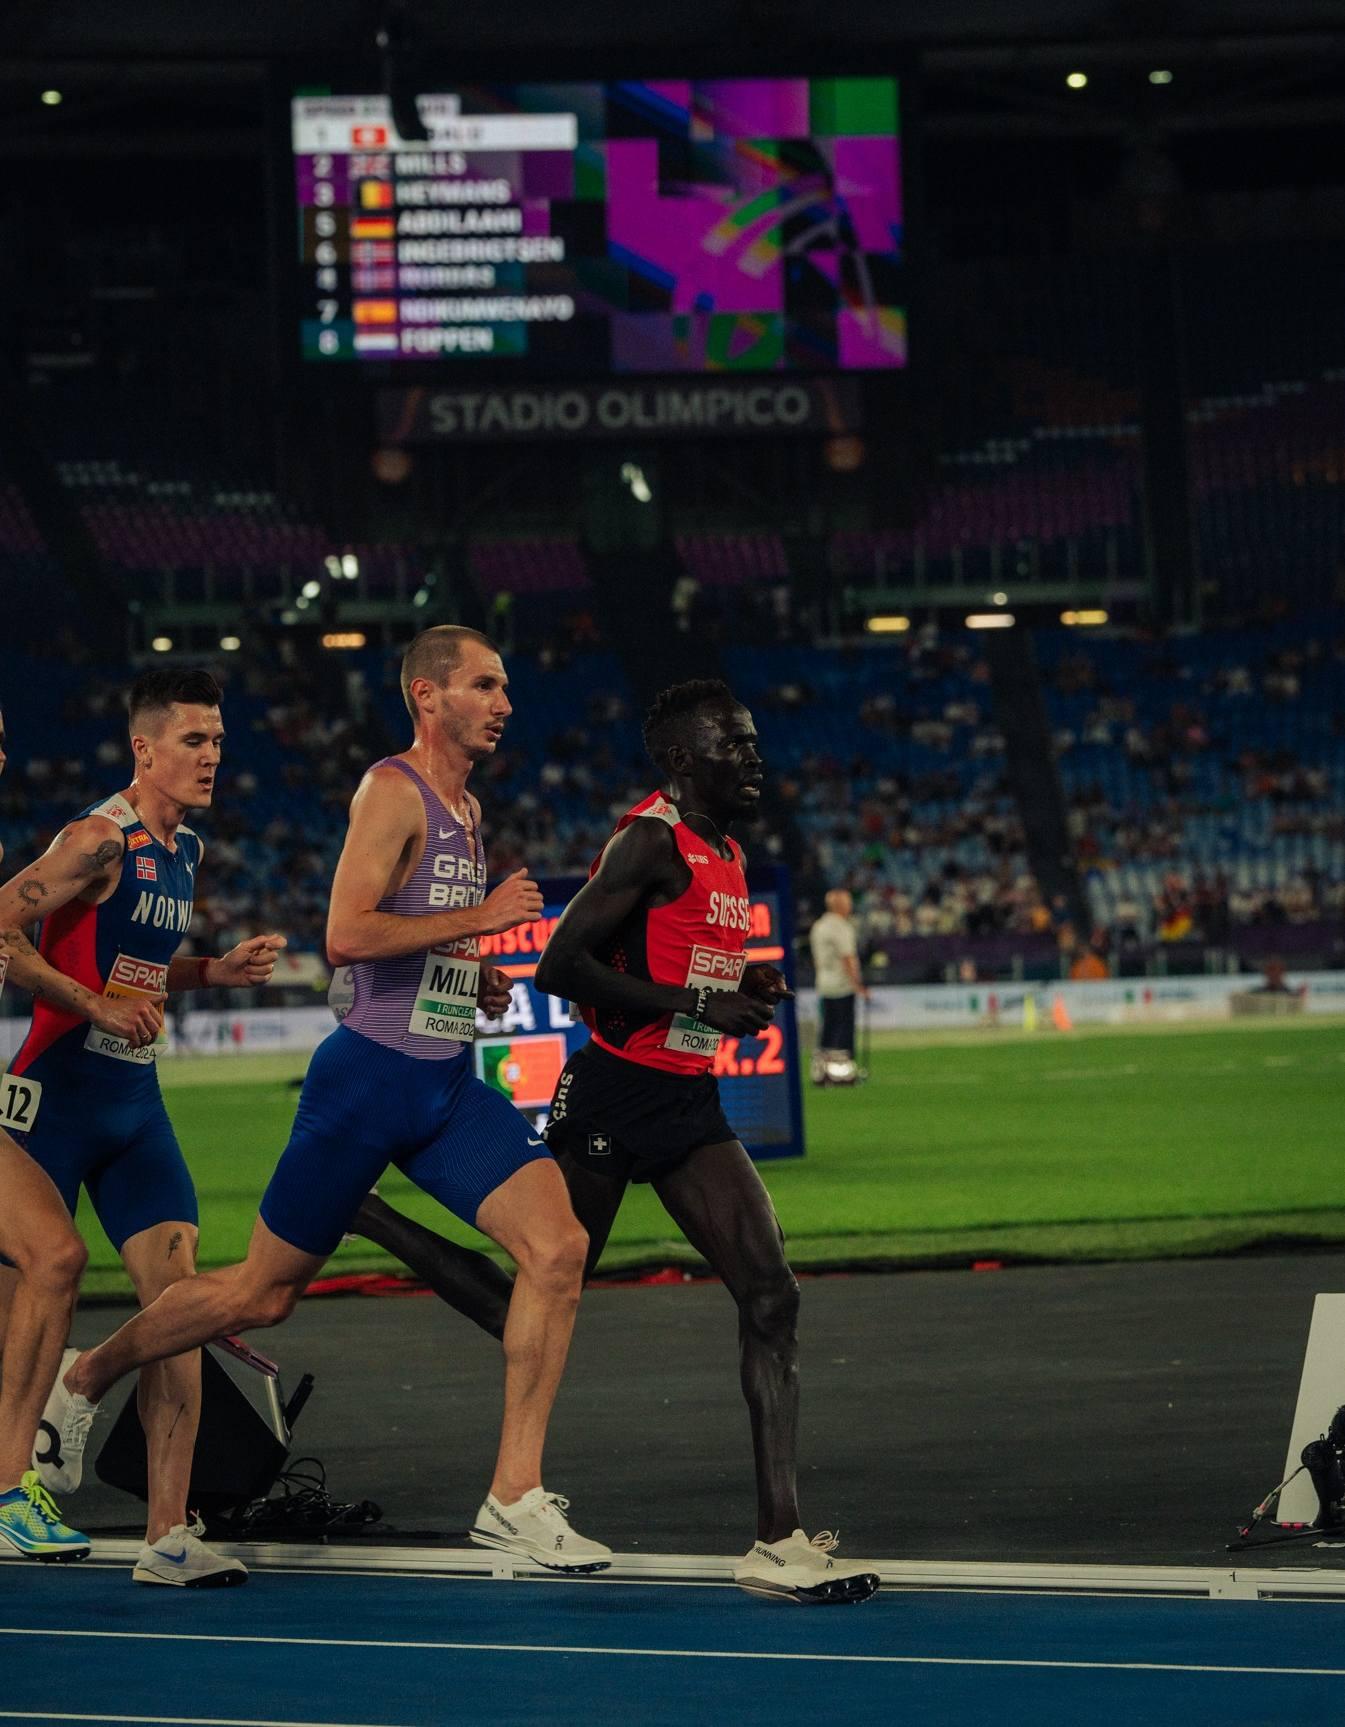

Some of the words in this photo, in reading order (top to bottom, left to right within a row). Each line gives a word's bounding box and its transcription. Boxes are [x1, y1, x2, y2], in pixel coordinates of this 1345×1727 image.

[430, 391, 589, 432] STADIO
[596, 387, 811, 428] OLIMPICO
[694, 951, 743, 977] SPAR
[100, 1038, 134, 1057] ROMA
[6, 1085, 32, 1124] 12
